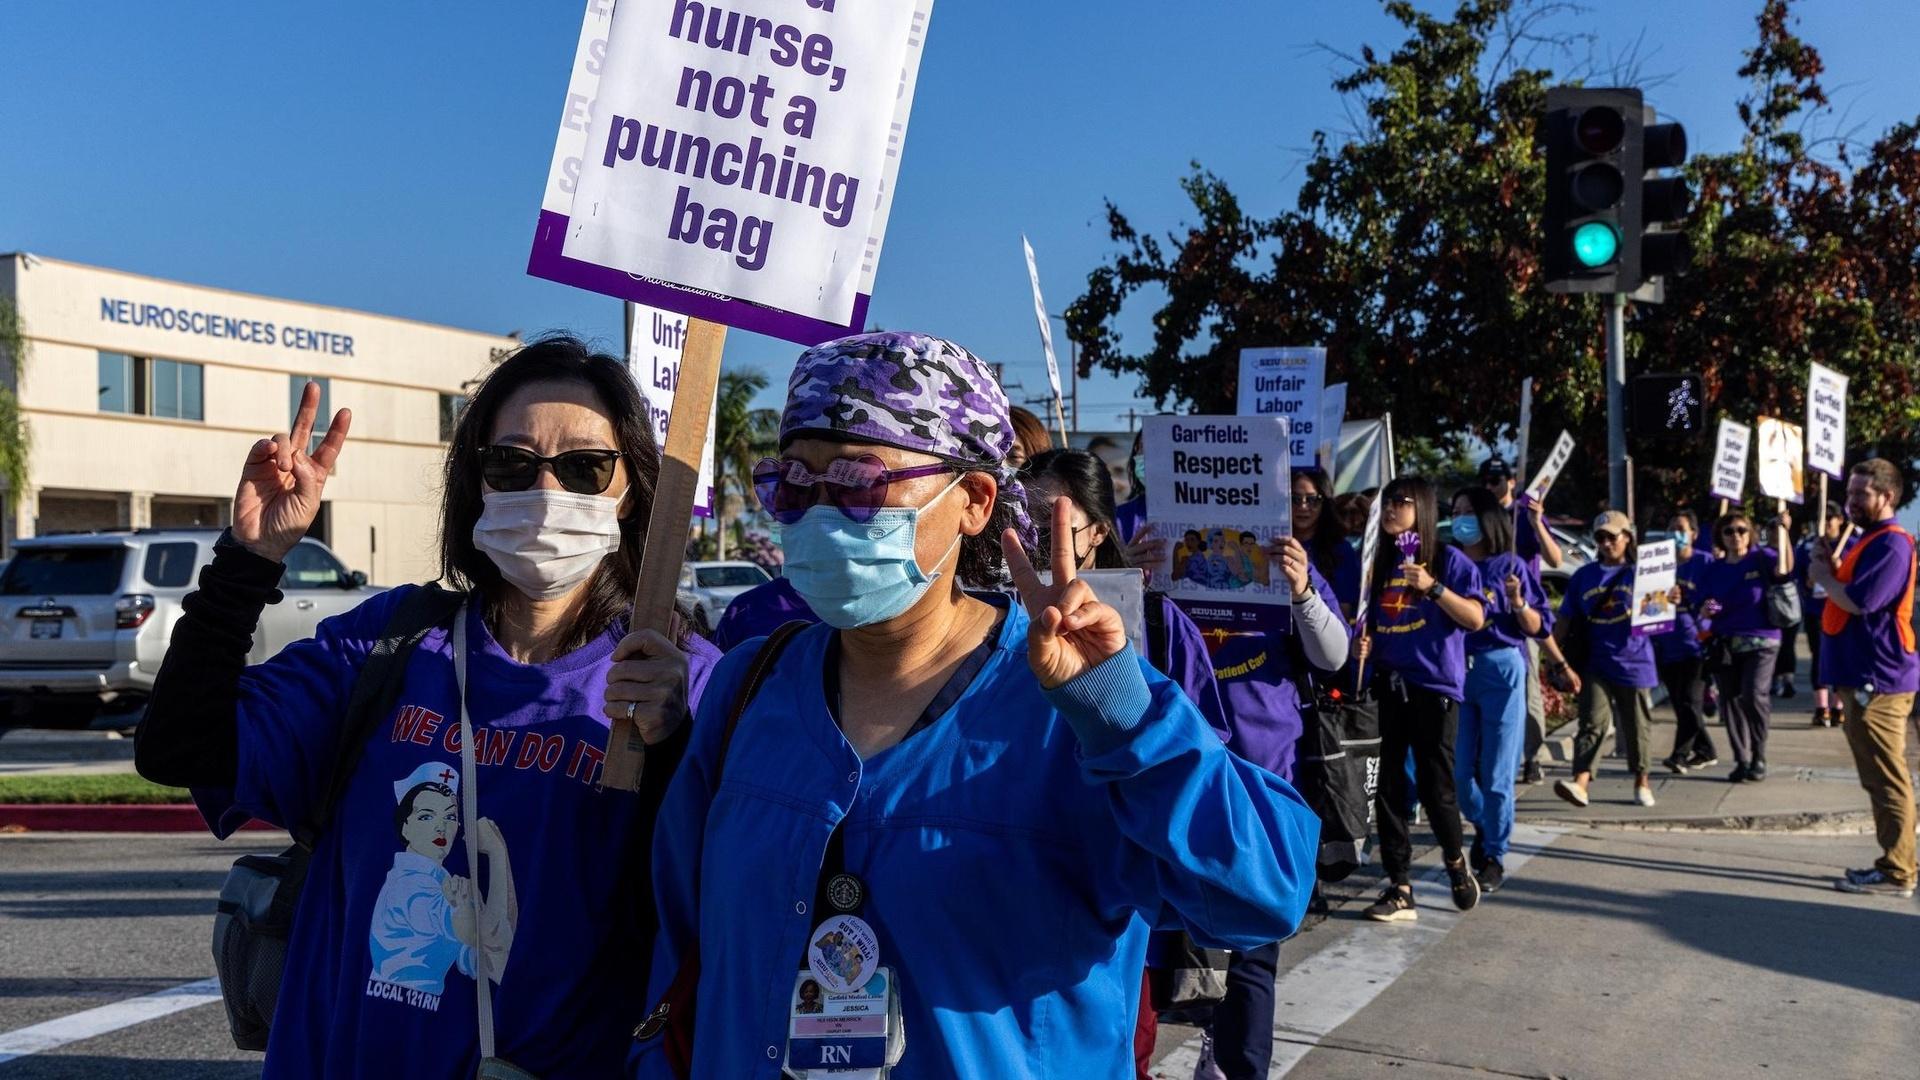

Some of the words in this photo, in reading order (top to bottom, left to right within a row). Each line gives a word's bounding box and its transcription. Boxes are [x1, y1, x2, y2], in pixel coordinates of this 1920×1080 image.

[669, 0, 847, 92] nurse,
[676, 66, 775, 128] not
[783, 94, 817, 139] a
[603, 115, 860, 228] punching
[668, 186, 774, 271] bag
[100, 297, 276, 345] NEUROSCIENCES
[282, 326, 354, 356] CENTER
[1255, 376, 1305, 392] Unfair
[1256, 397, 1303, 413] Labor
[1172, 424, 1248, 443] Garfield:
[1173, 451, 1262, 478] Respect
[1174, 481, 1259, 505] Nurses!
[391, 704, 444, 746] WE
[443, 721, 515, 766] CAN
[515, 732, 565, 772] DO
[839, 921, 854, 936] BUT
[856, 939, 873, 961] WILL!
[366, 978, 403, 1002] LOCAL
[405, 986, 441, 1012] 121RN
[820, 1045, 853, 1064] RN
